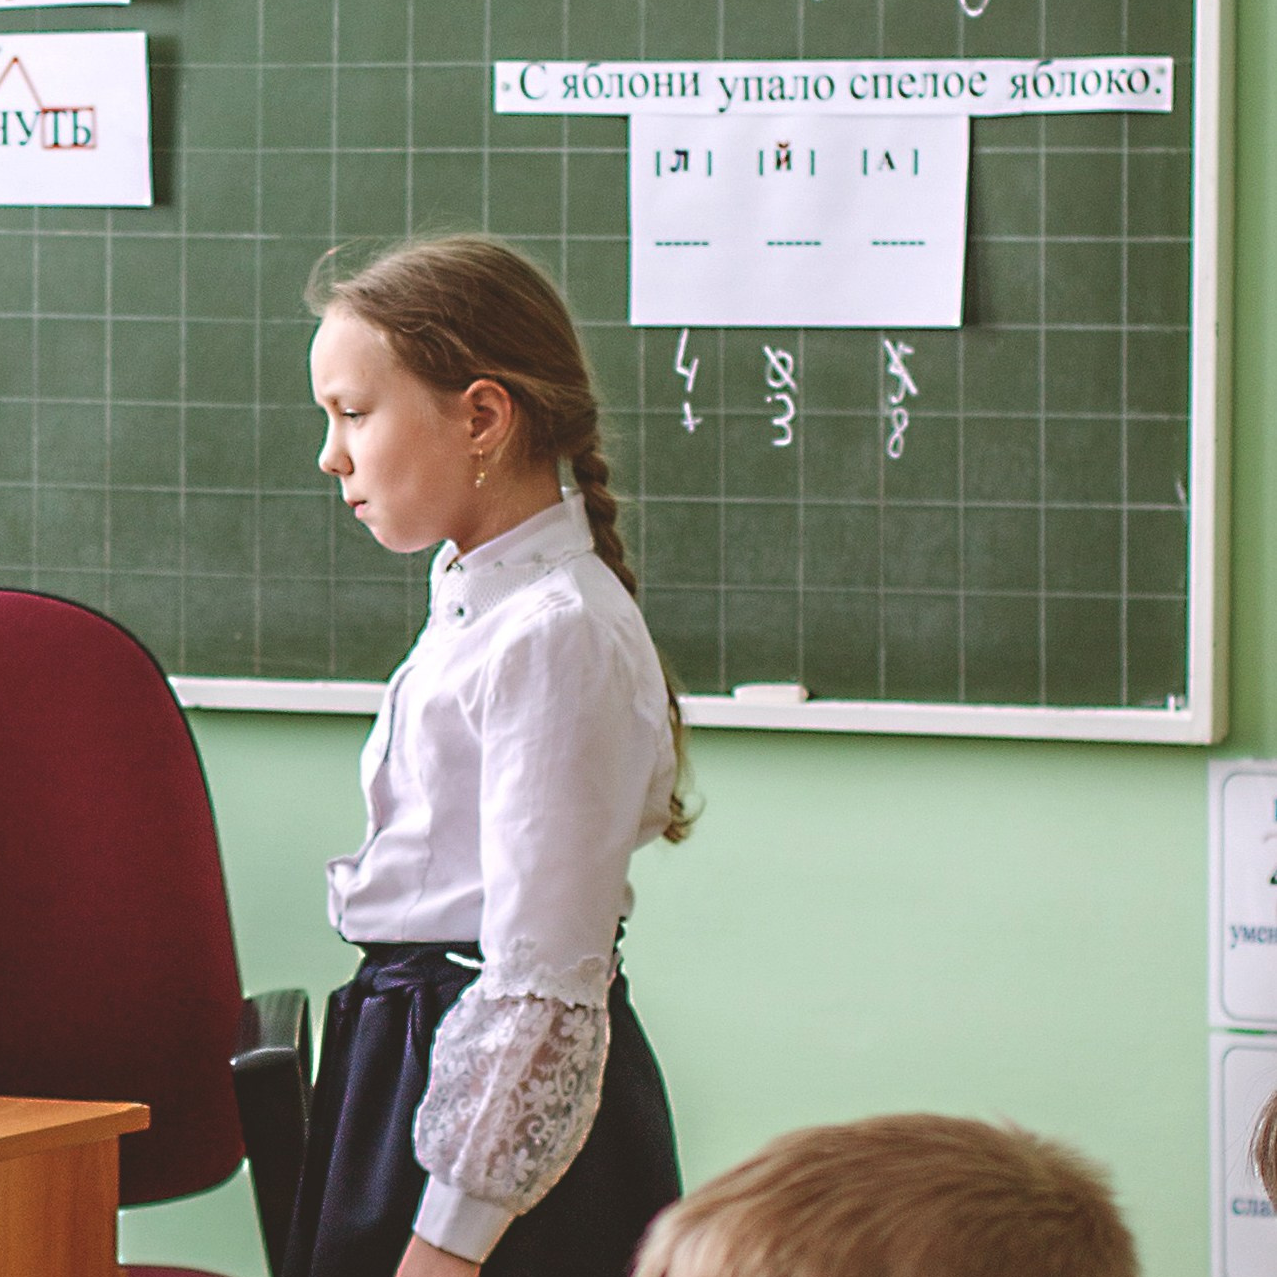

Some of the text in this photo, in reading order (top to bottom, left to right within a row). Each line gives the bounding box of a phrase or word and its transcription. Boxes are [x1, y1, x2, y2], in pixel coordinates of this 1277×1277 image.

[519, 58, 1162, 114] С яблони упало спелое яблоко.
